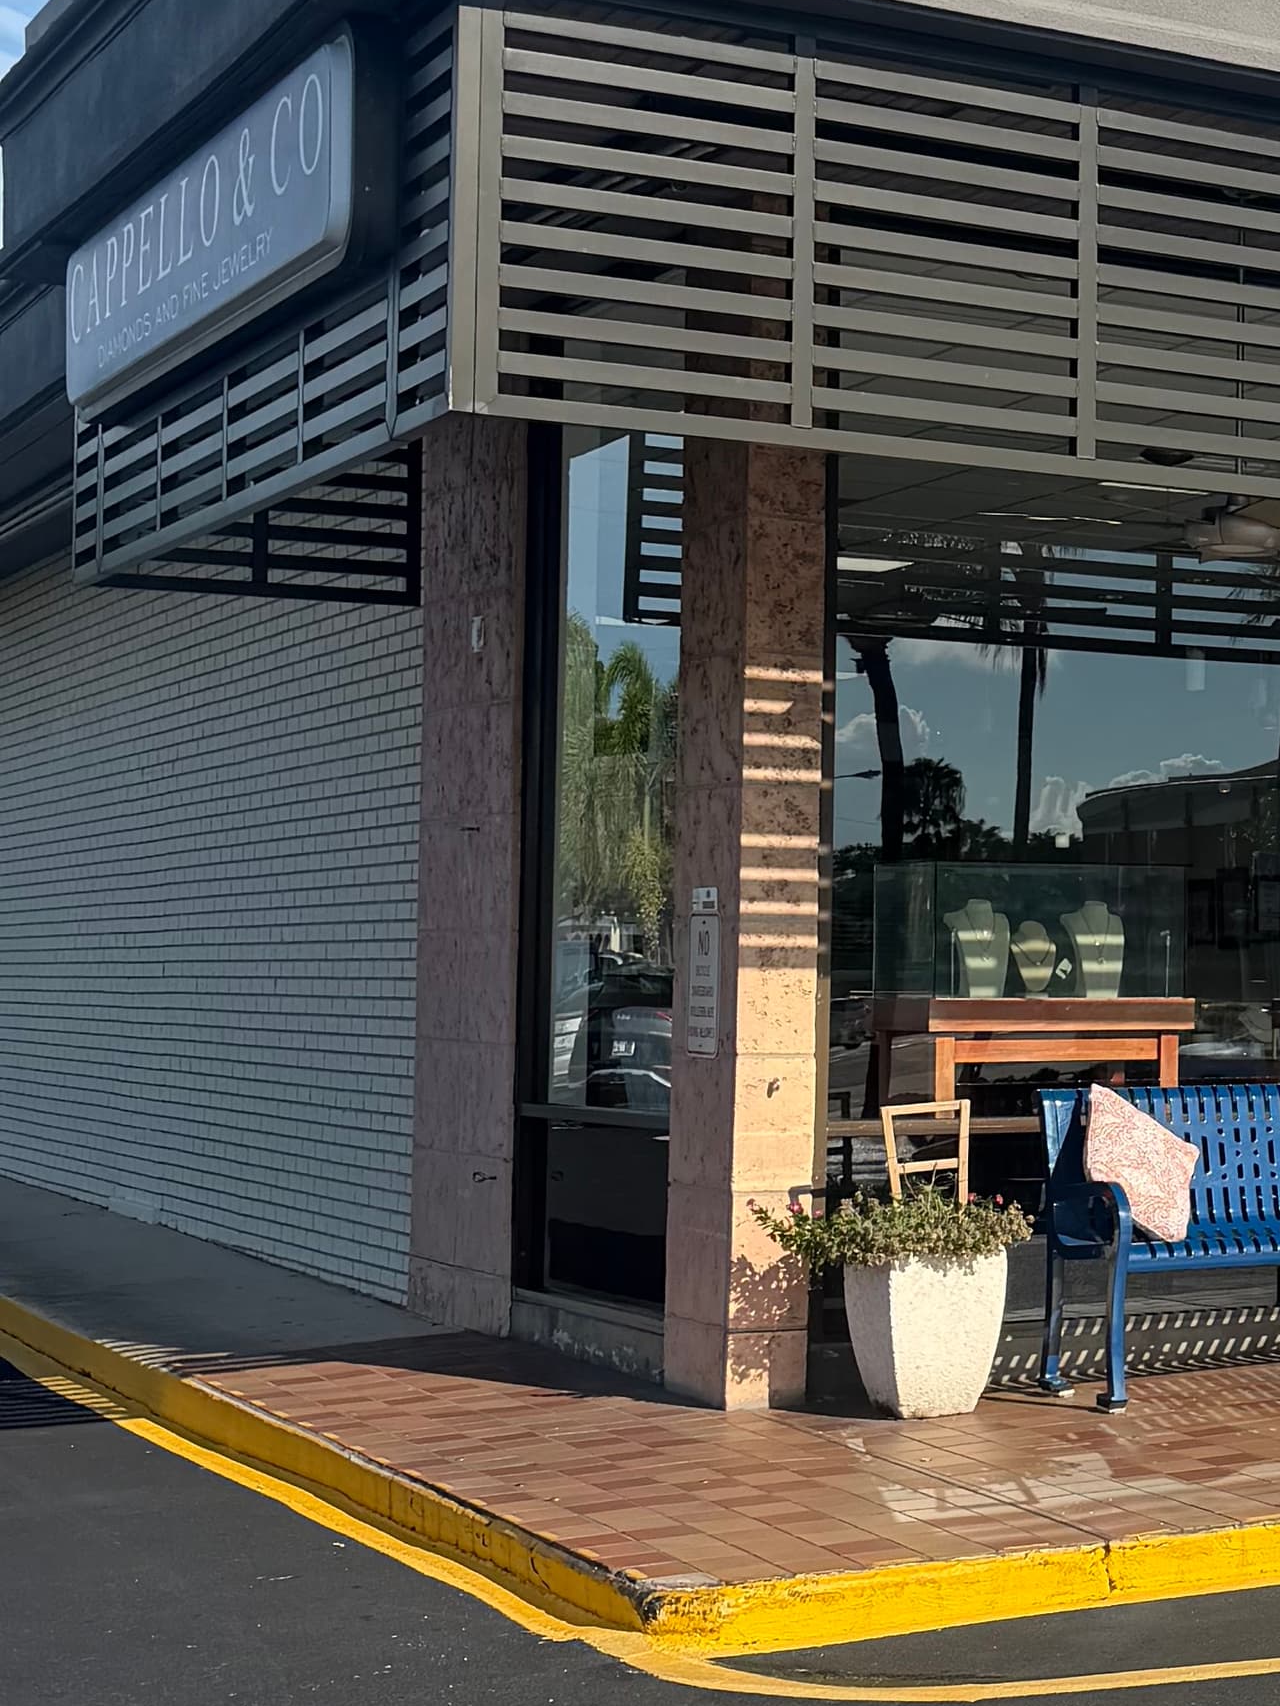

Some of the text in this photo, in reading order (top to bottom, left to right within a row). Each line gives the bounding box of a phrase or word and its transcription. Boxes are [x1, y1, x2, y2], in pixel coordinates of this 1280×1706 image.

[70, 73, 323, 344] CAPPELLO & CO
[97, 226, 273, 369] DIAMONDS AND FINE JEWELRY
[697, 930, 711, 957] NO
